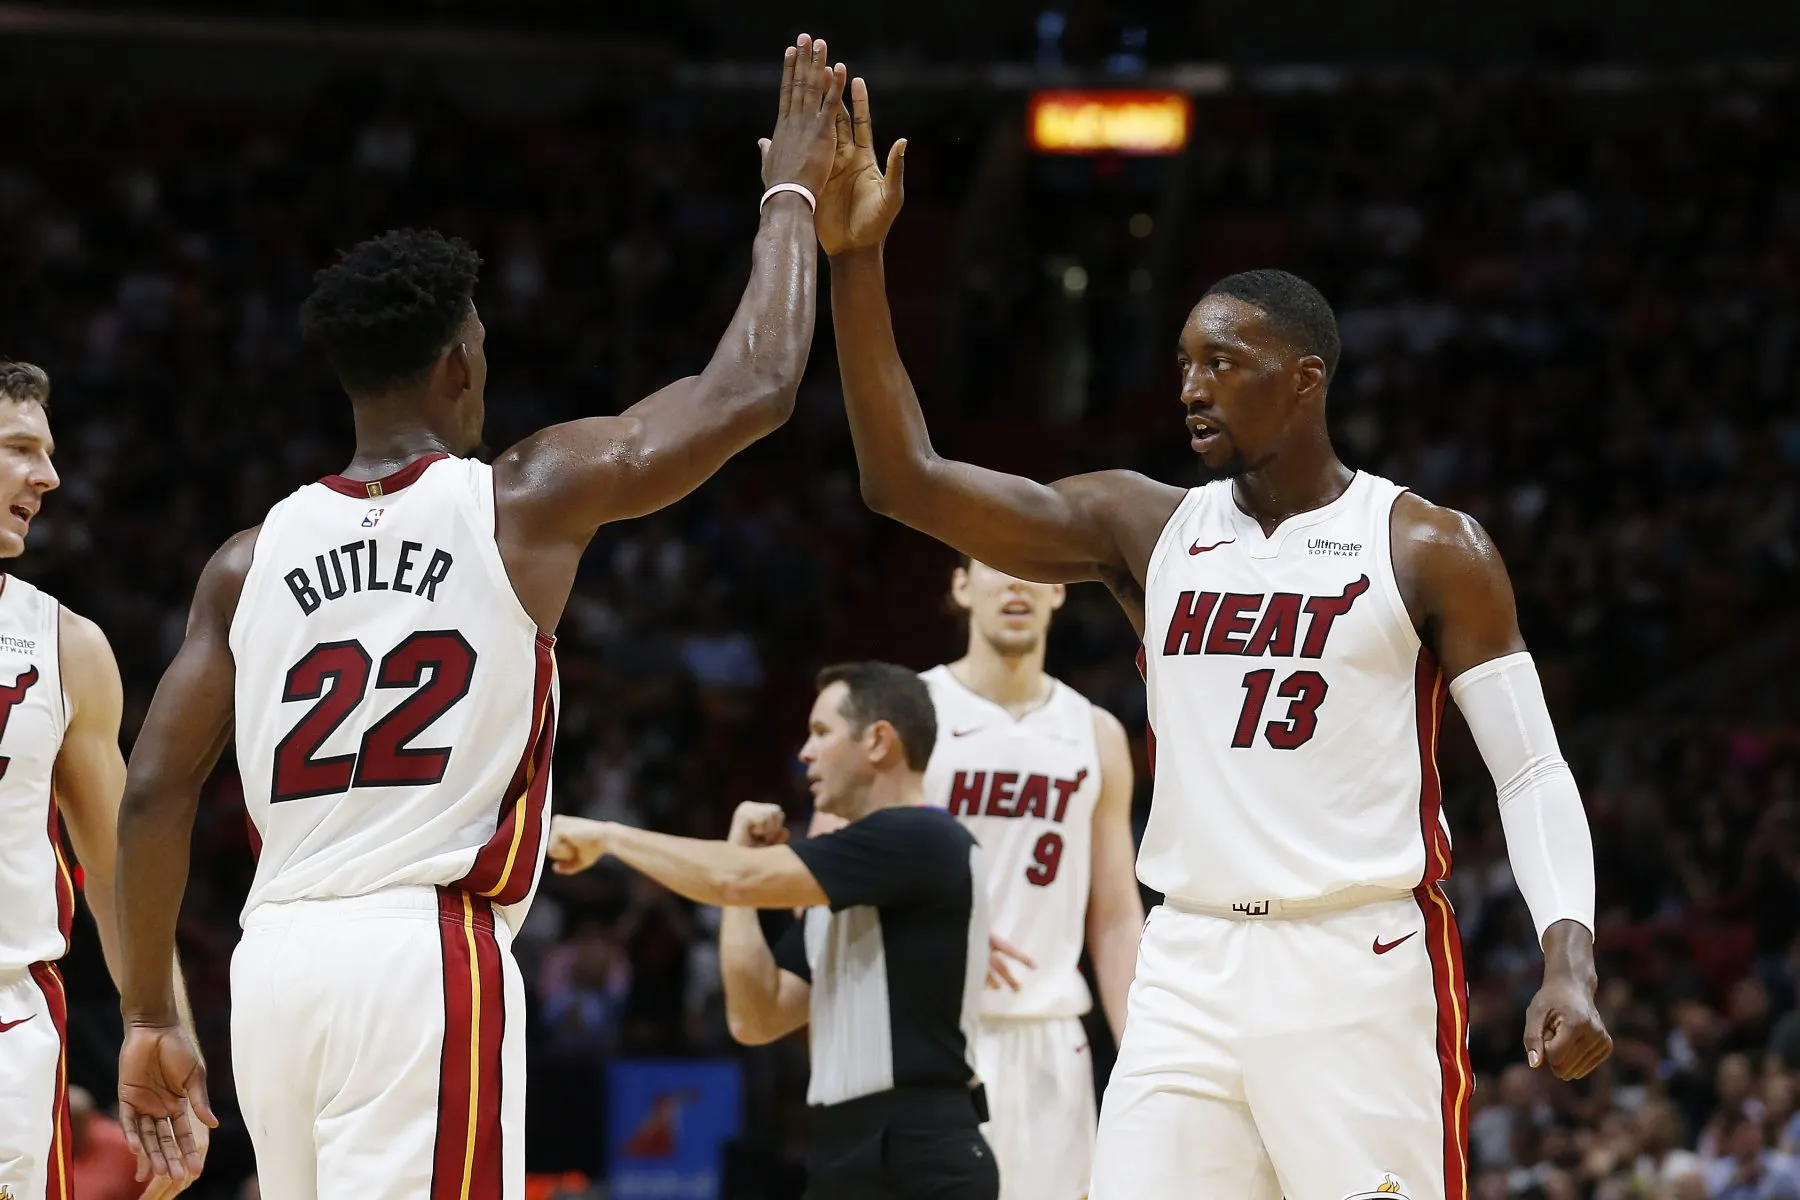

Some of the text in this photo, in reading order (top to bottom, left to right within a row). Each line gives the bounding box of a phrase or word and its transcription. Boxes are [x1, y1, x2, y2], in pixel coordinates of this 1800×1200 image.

[283, 538, 454, 617] BUTLER
[1307, 538, 1363, 551] Ultimate
[1308, 549, 1360, 557] SOFTWARE
[1162, 573, 1371, 660] HEAT
[270, 629, 478, 804] 22
[1231, 668, 1330, 750] 13
[949, 767, 1090, 823] HEAT
[1025, 830, 1065, 887] 9
